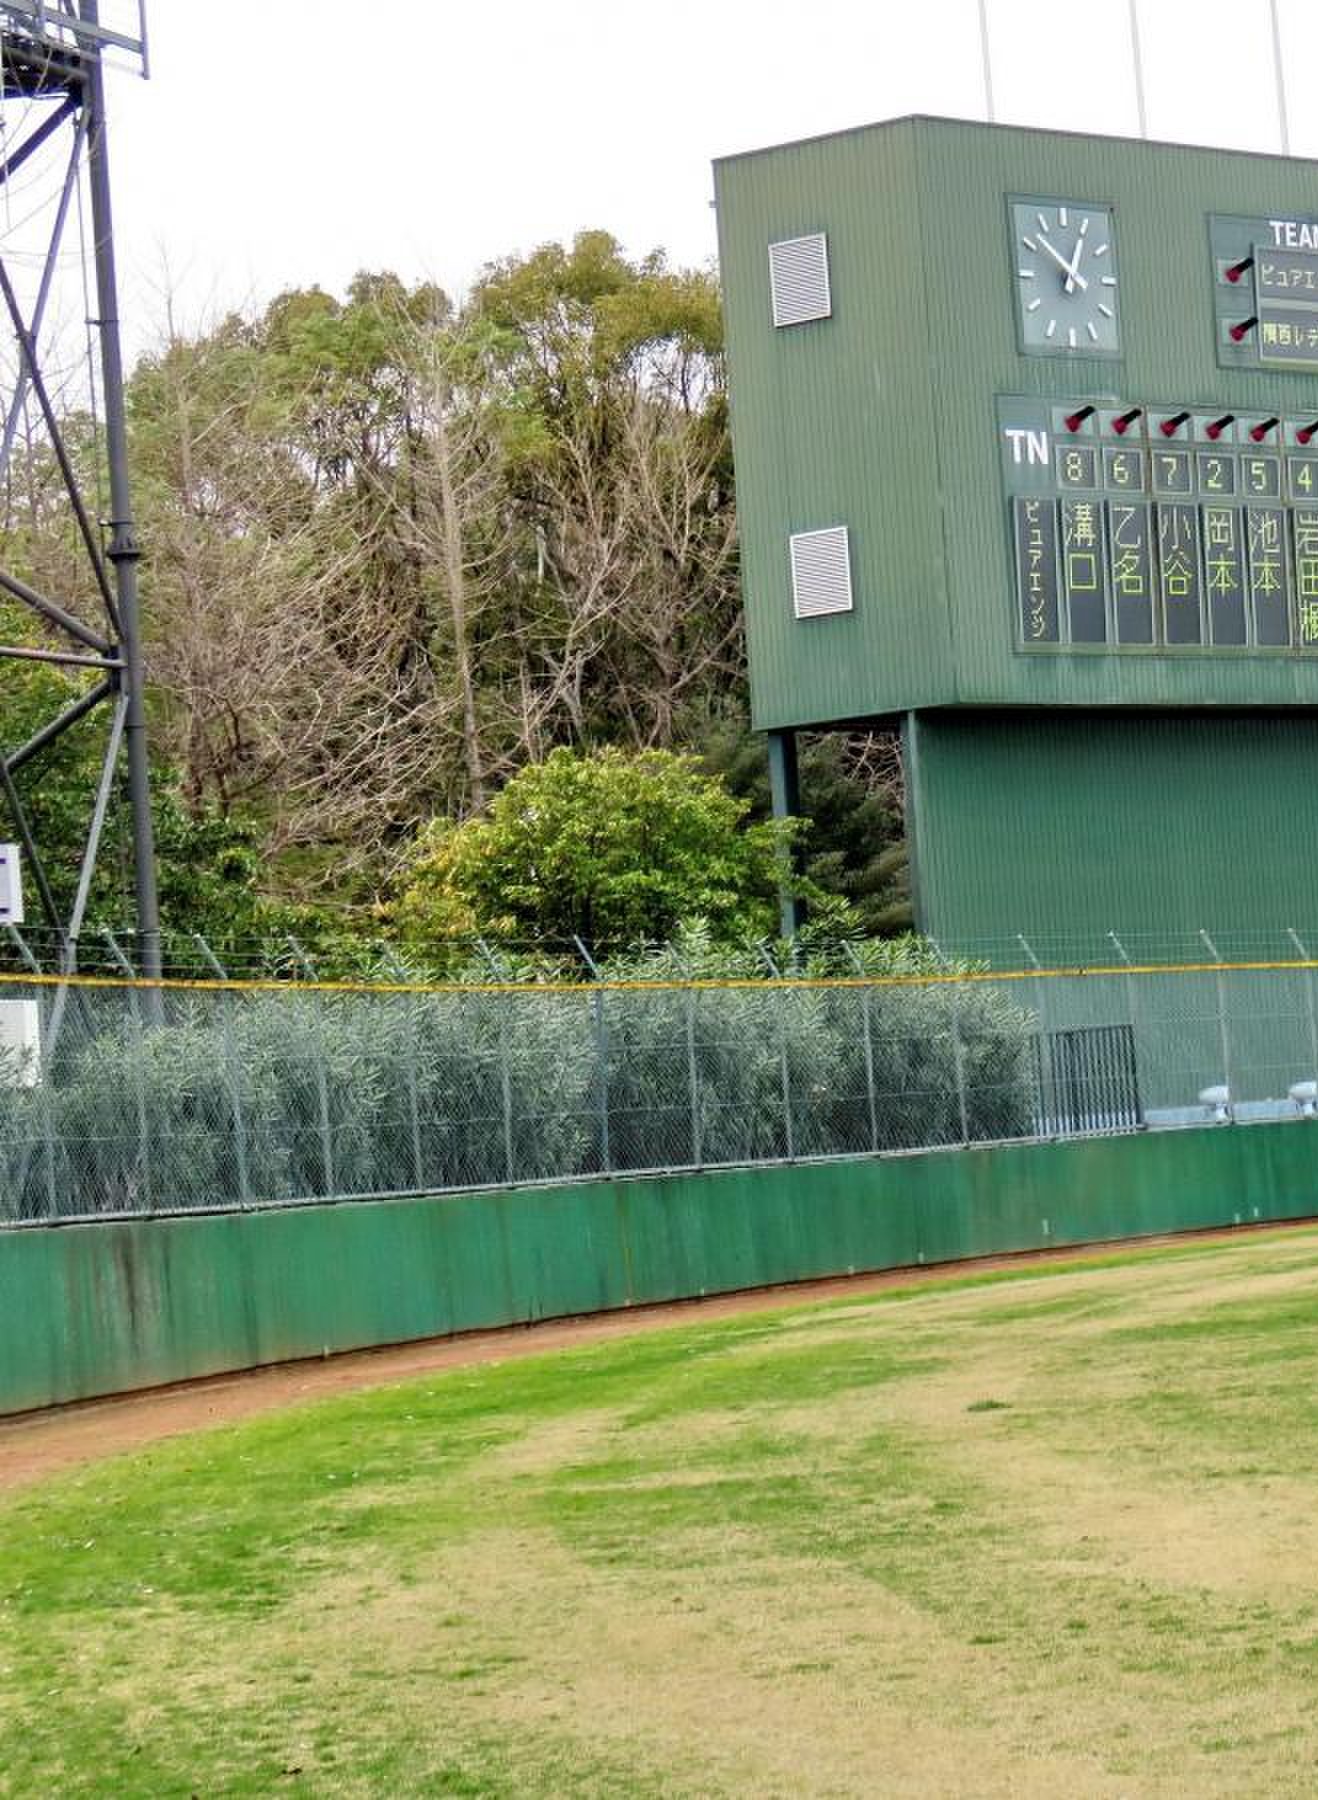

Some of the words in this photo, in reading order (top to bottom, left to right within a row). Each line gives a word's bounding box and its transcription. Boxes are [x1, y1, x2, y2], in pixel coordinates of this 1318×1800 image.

[1005, 429, 1049, 465] TN
[1066, 452, 1083, 481] 8
[1113, 454, 1129, 484] 6
[1162, 457, 1177, 486] 7
[1207, 459, 1222, 489] 2
[1251, 462, 1267, 490] 5
[1298, 464, 1312, 492] 4
[1205, 508, 1238, 597] 岡本
